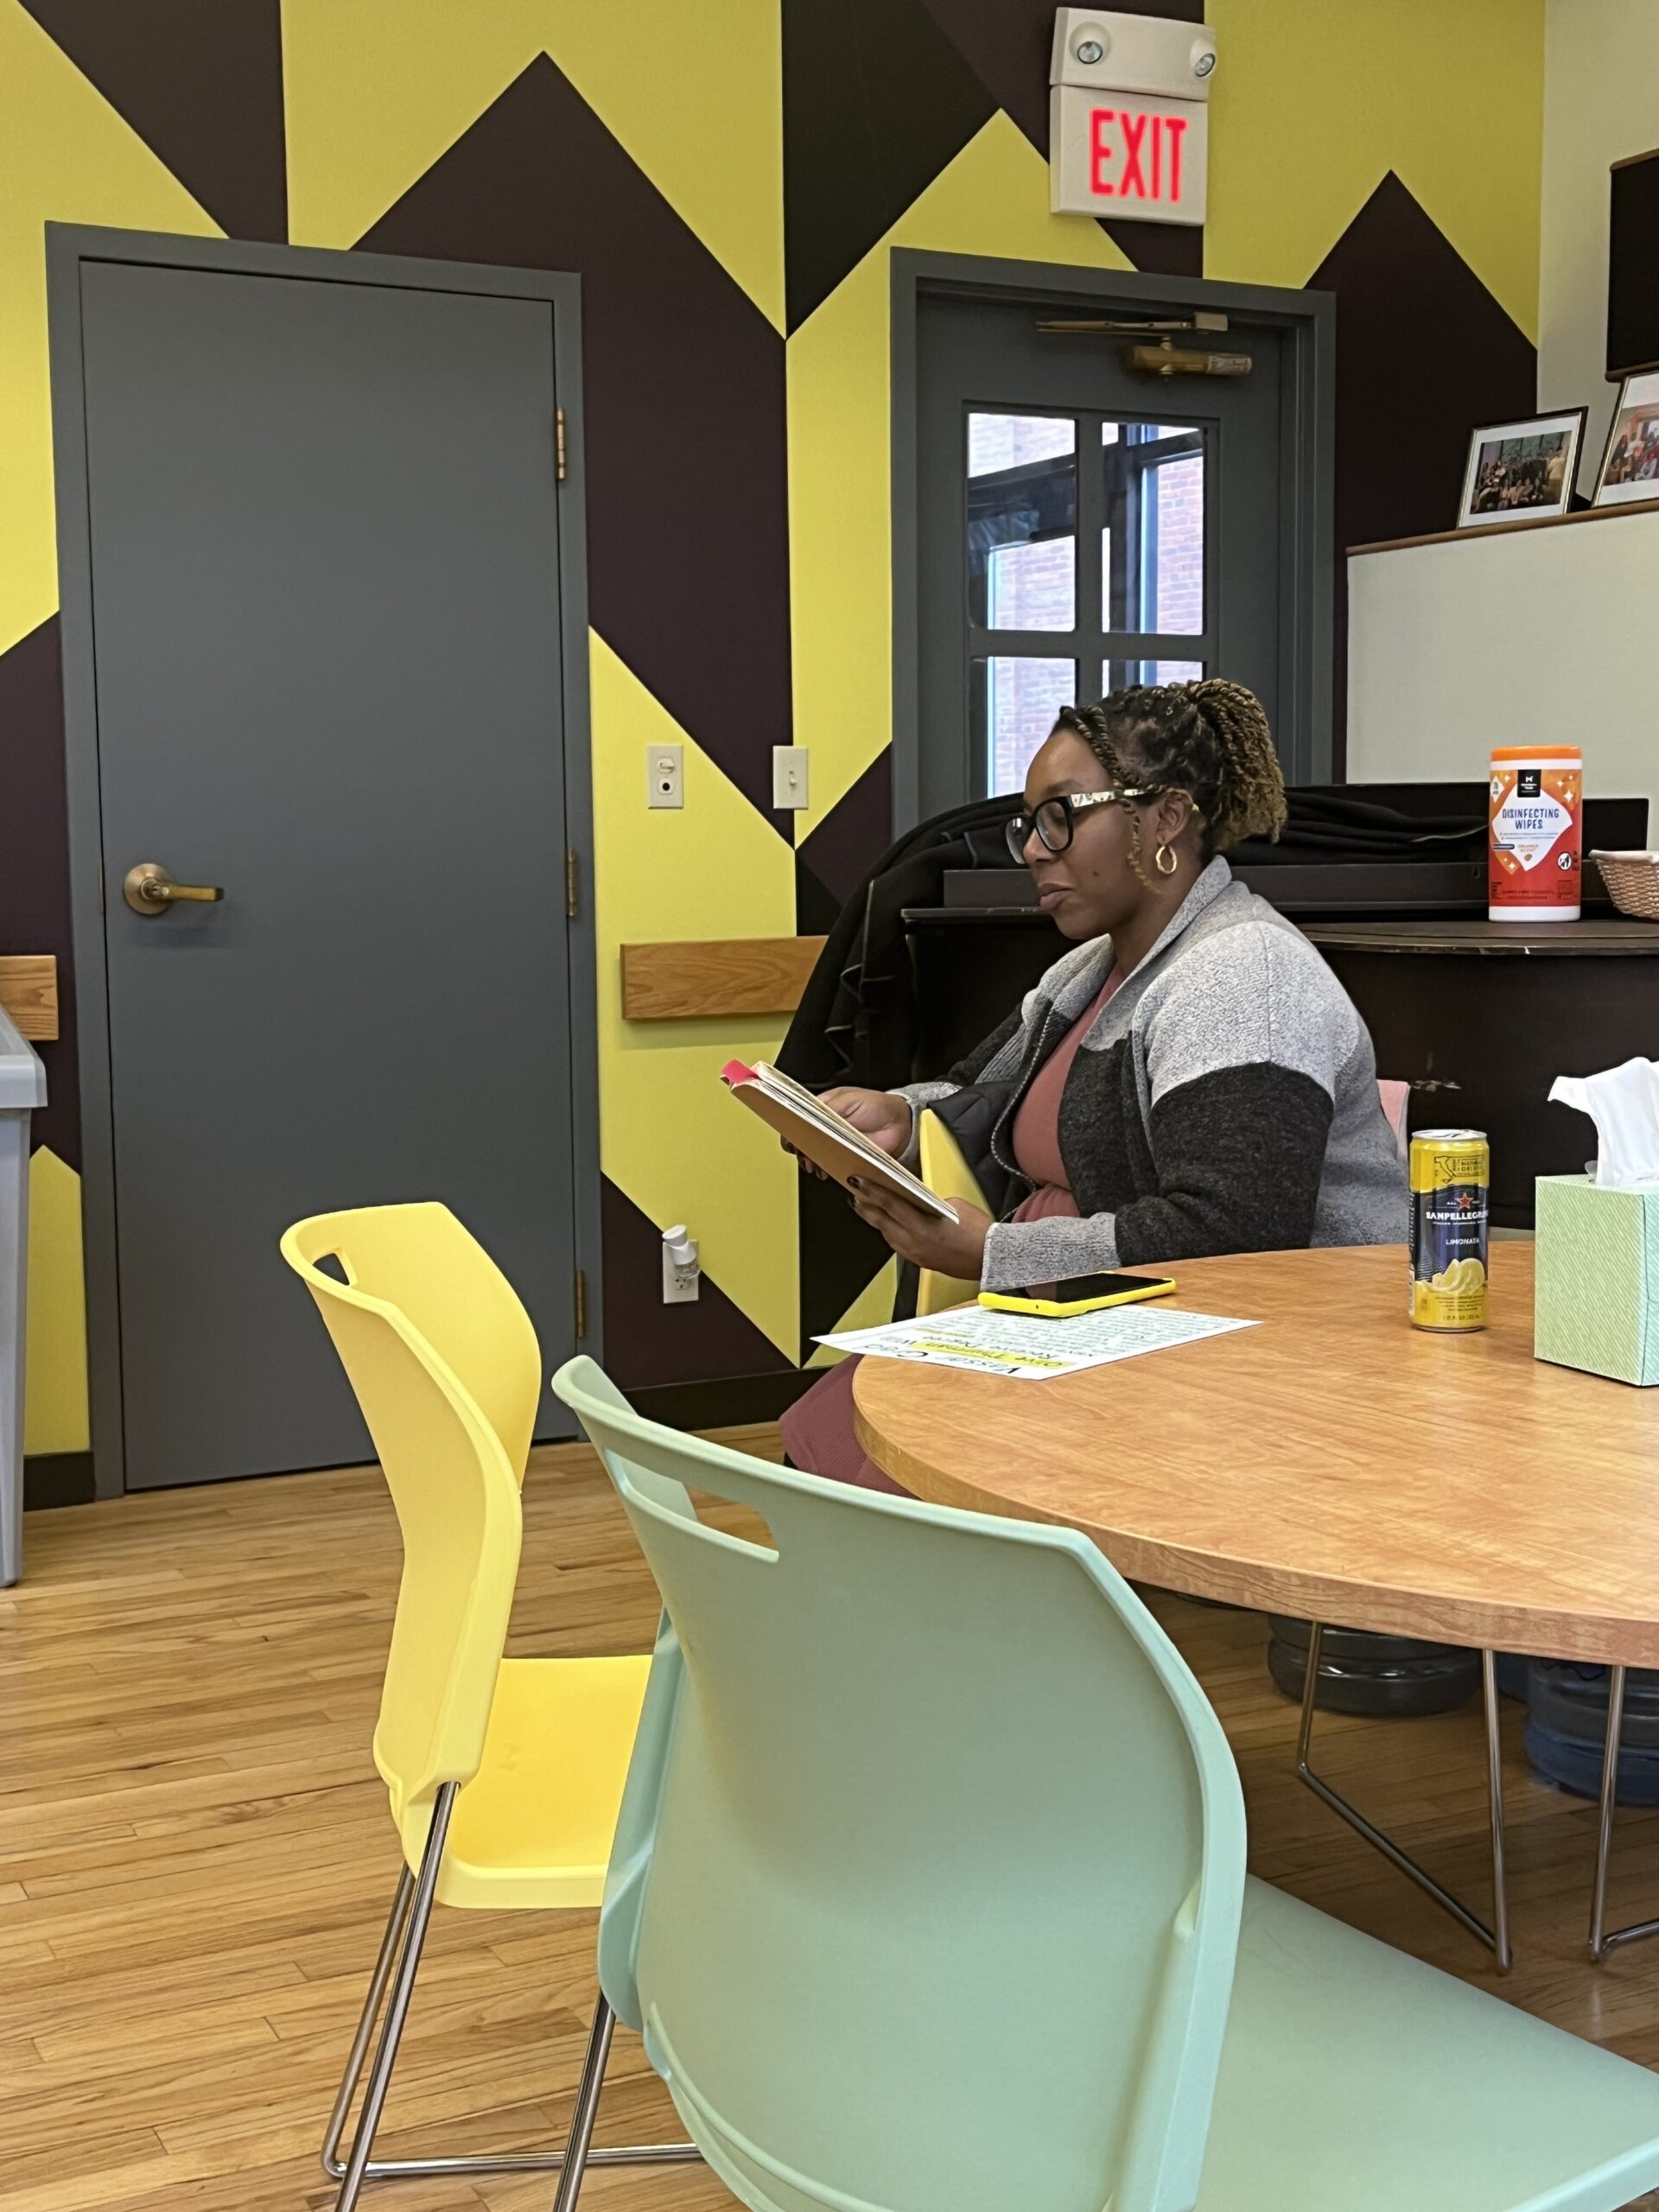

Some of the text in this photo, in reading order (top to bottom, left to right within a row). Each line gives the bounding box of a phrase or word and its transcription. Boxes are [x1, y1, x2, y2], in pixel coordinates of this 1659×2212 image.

[1090, 108, 1188, 202] EXIT
[1502, 808, 1560, 819] DISINFECTING
[1515, 819, 1543, 830] WIPES
[925, 1343, 1063, 1368] Olive Thurman
[934, 1357, 1021, 1374] Vassar
